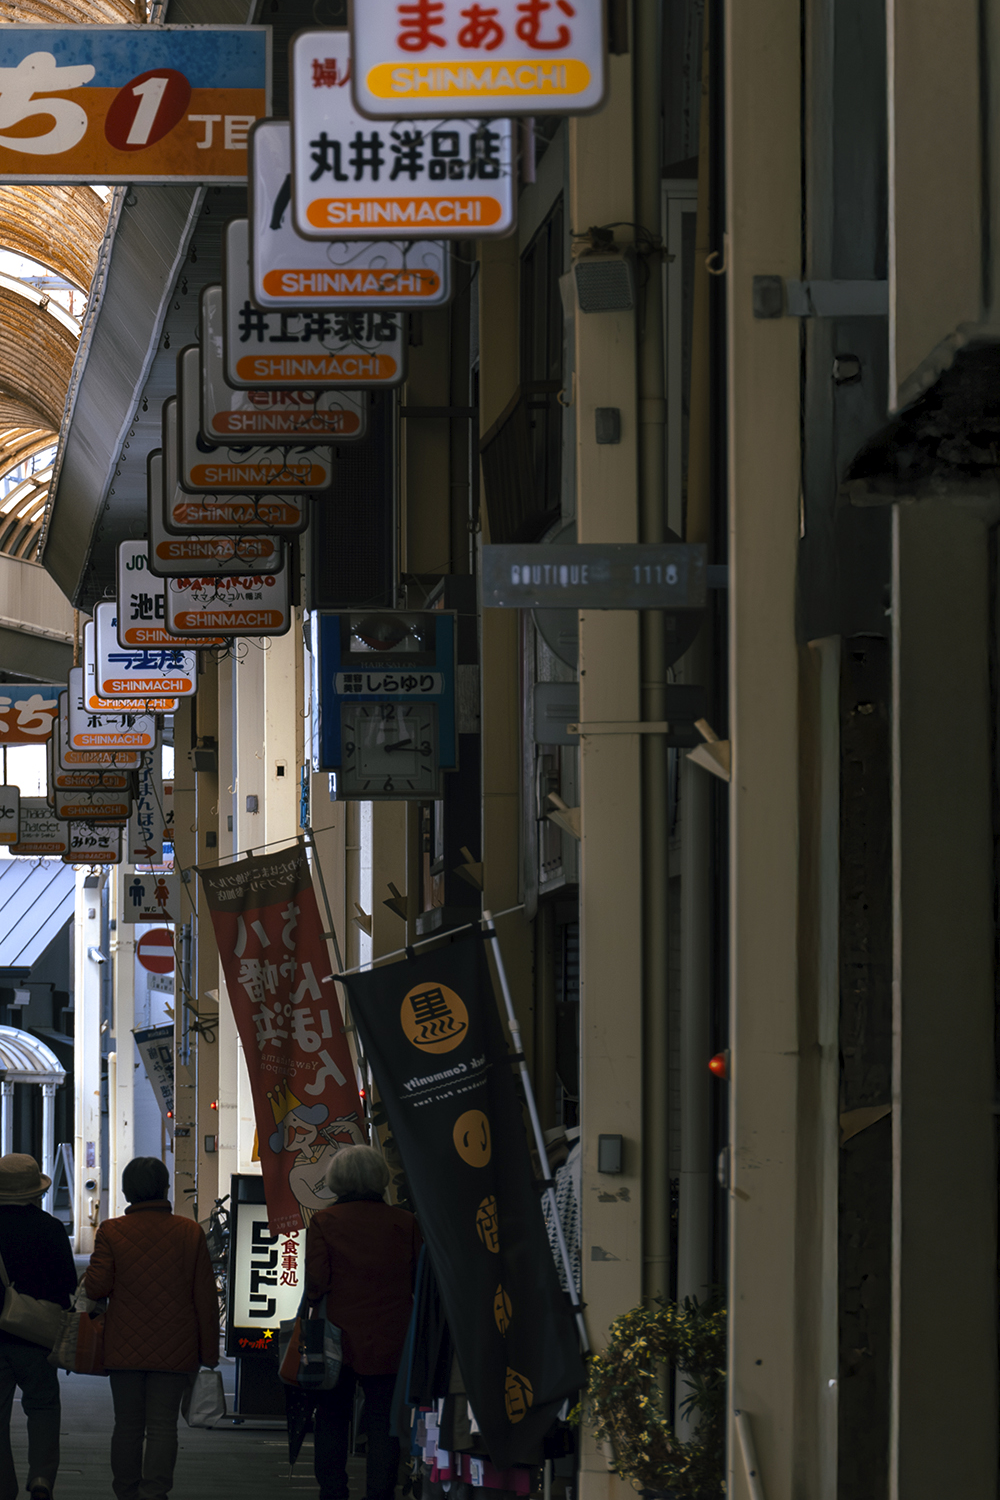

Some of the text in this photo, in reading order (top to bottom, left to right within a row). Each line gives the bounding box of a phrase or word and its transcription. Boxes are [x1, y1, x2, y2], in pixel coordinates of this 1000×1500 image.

[391, 64, 567, 93] SHINMACHI
[310, 130, 500, 182] 丸井洋品店
[327, 201, 481, 224] SHINMACHI
[281, 273, 422, 293] SHINMACHI
[254, 358, 380, 376] SHINMACHI
[228, 414, 344, 430] SHINMACHI
[204, 467, 312, 483] SHINMACHI
[187, 506, 286, 522] SHINMACHI
[169, 544, 262, 556] SHINMACHI
[511, 564, 678, 587] BOUTIQUE 1118
[186, 615, 272, 626] SHINMACHI
[112, 681, 183, 691] SHINMACHI
[343, 674, 362, 683] 理容
[367, 675, 434, 692] しらゆり
[343, 684, 362, 693] 美容
[380, 704, 395, 720] 12
[82, 736, 143, 744] SHINMACHI
[346, 741, 432, 757] 9 3
[70, 753, 128, 762] SHINMACHI
[65, 777, 119, 785] SHINMACHI
[383, 777, 394, 792] 6
[68, 806, 121, 815] SHINMACHI
[71, 836, 110, 848] みゆき
[249, 1221, 278, 1317] ロンドン
